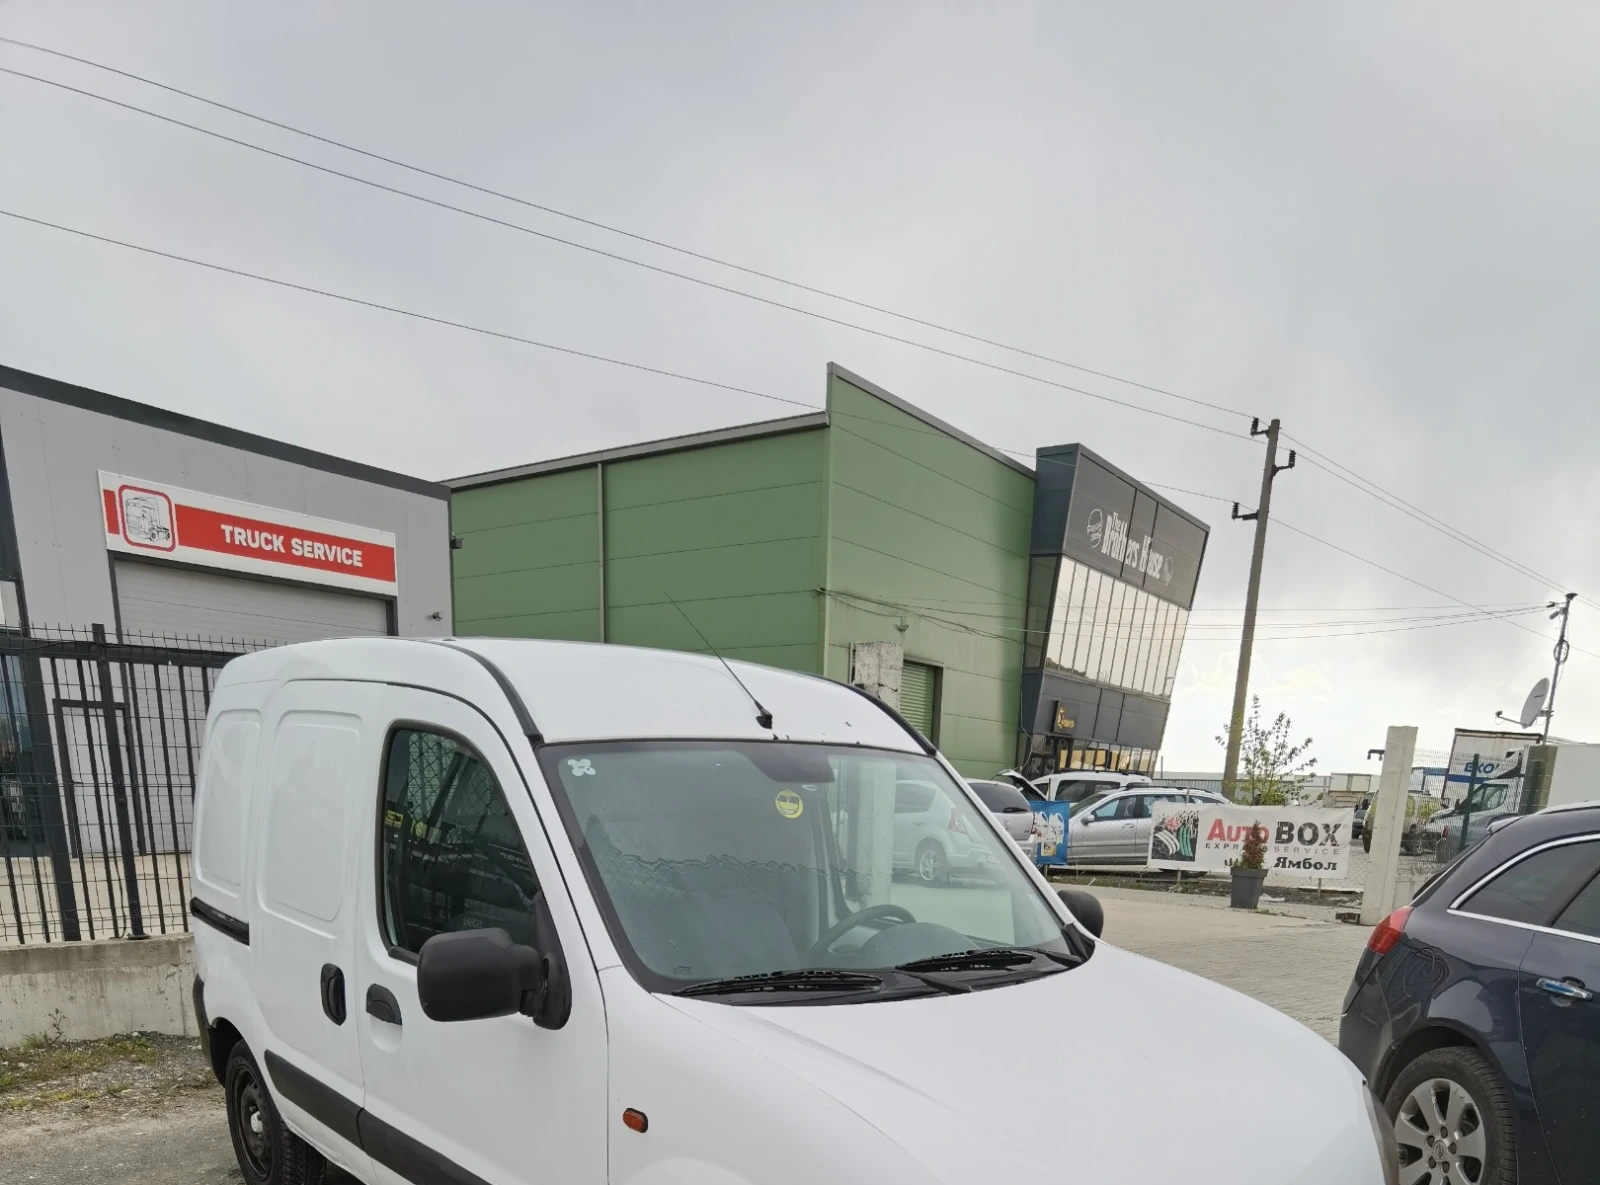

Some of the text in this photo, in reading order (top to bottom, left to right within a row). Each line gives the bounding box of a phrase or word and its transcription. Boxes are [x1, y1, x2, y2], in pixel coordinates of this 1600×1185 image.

[220, 524, 363, 567] TRUCK SERVICE
[1274, 821, 1342, 847] BOX
[1274, 847, 1340, 855] SERVICE
[1273, 856, 1338, 871] Ямбол
